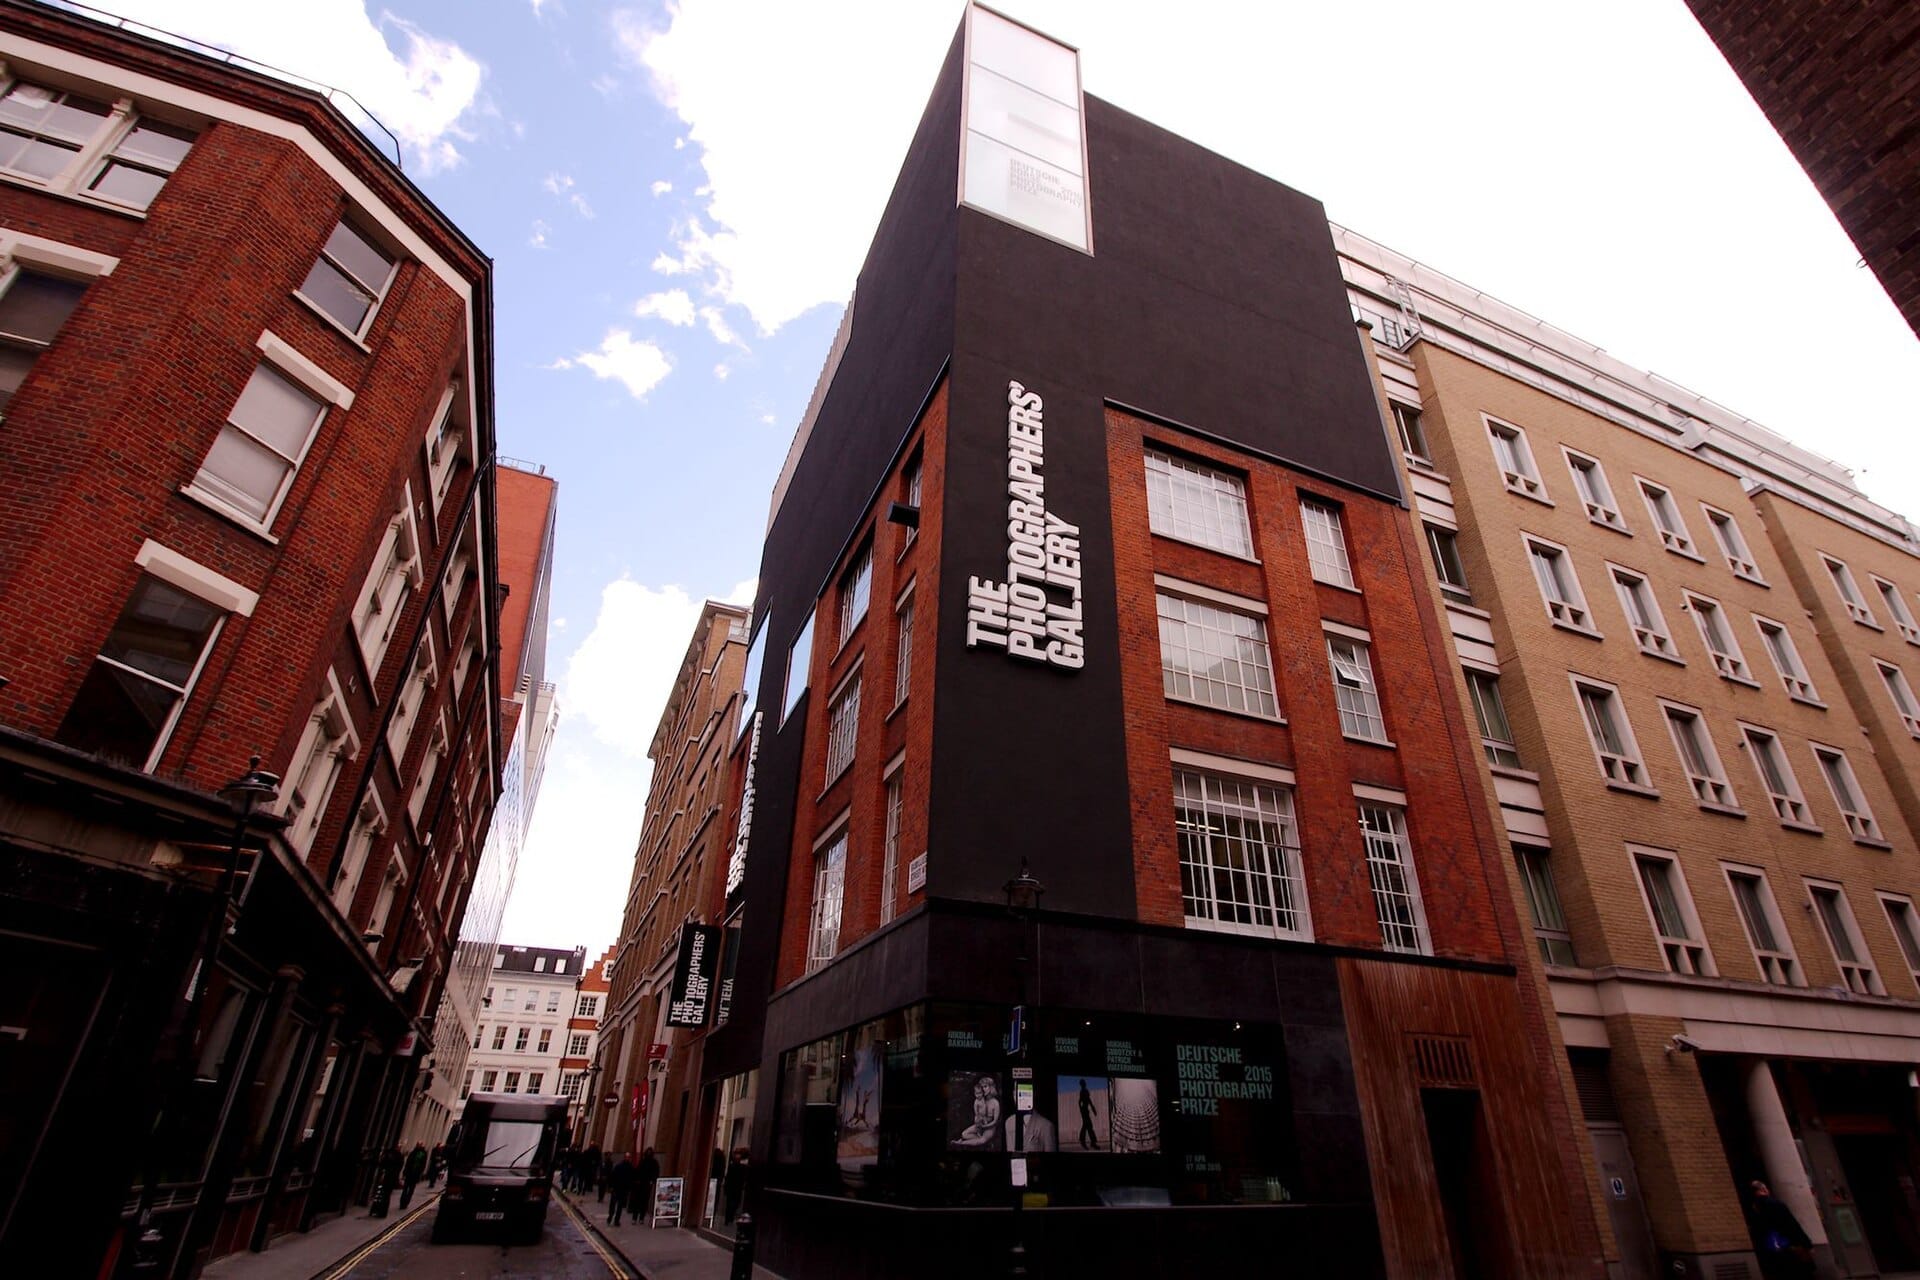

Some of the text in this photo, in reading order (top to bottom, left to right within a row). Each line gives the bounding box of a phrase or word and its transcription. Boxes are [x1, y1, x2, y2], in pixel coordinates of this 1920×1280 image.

[1008, 379, 1046, 661] PHOTOGRAPHERS'
[1045, 511, 1085, 670] GALLERY
[966, 574, 1008, 648] THE
[681, 931, 706, 1024] PHOTOGRAPHERS'
[670, 1001, 684, 1022] THE
[692, 976, 709, 1024] GALLERY
[1176, 1044, 1242, 1064] DEUTSCHE
[1179, 1080, 1273, 1100] PHOTOGRAPHY
[1244, 1065, 1272, 1082] 2015
[1180, 1098, 1219, 1116] PRIZE
